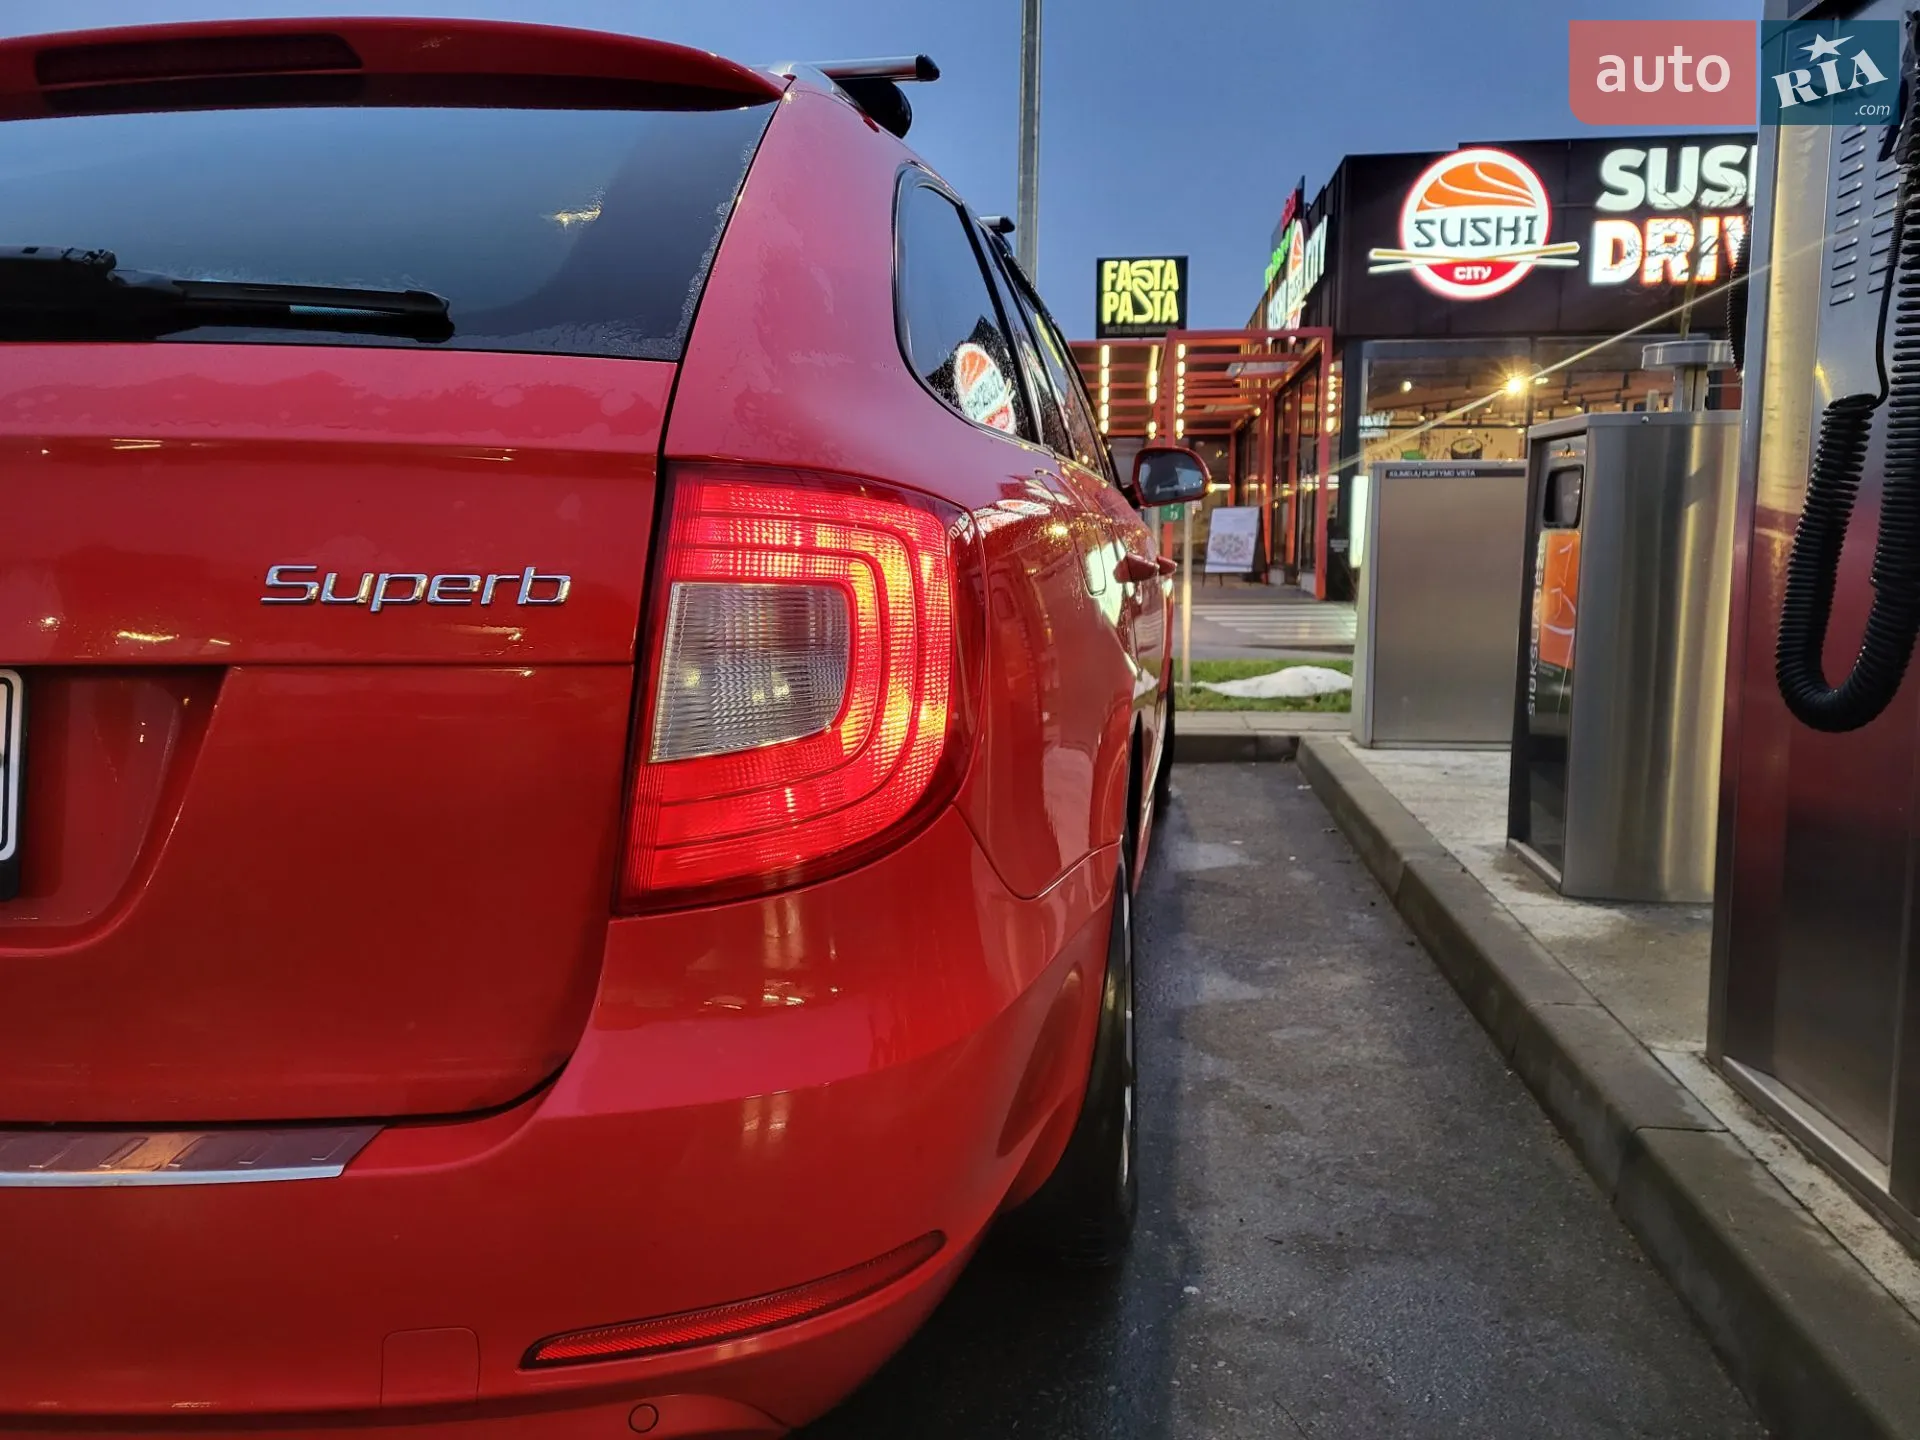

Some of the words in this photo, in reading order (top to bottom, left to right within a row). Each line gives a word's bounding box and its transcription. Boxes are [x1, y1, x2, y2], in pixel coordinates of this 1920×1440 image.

[1413, 215, 1538, 248] SUSHI
[1102, 259, 1179, 292] FASTA
[1454, 266, 1492, 280] CITY
[1102, 287, 1179, 324] PASTA
[261, 564, 571, 612] Superb
